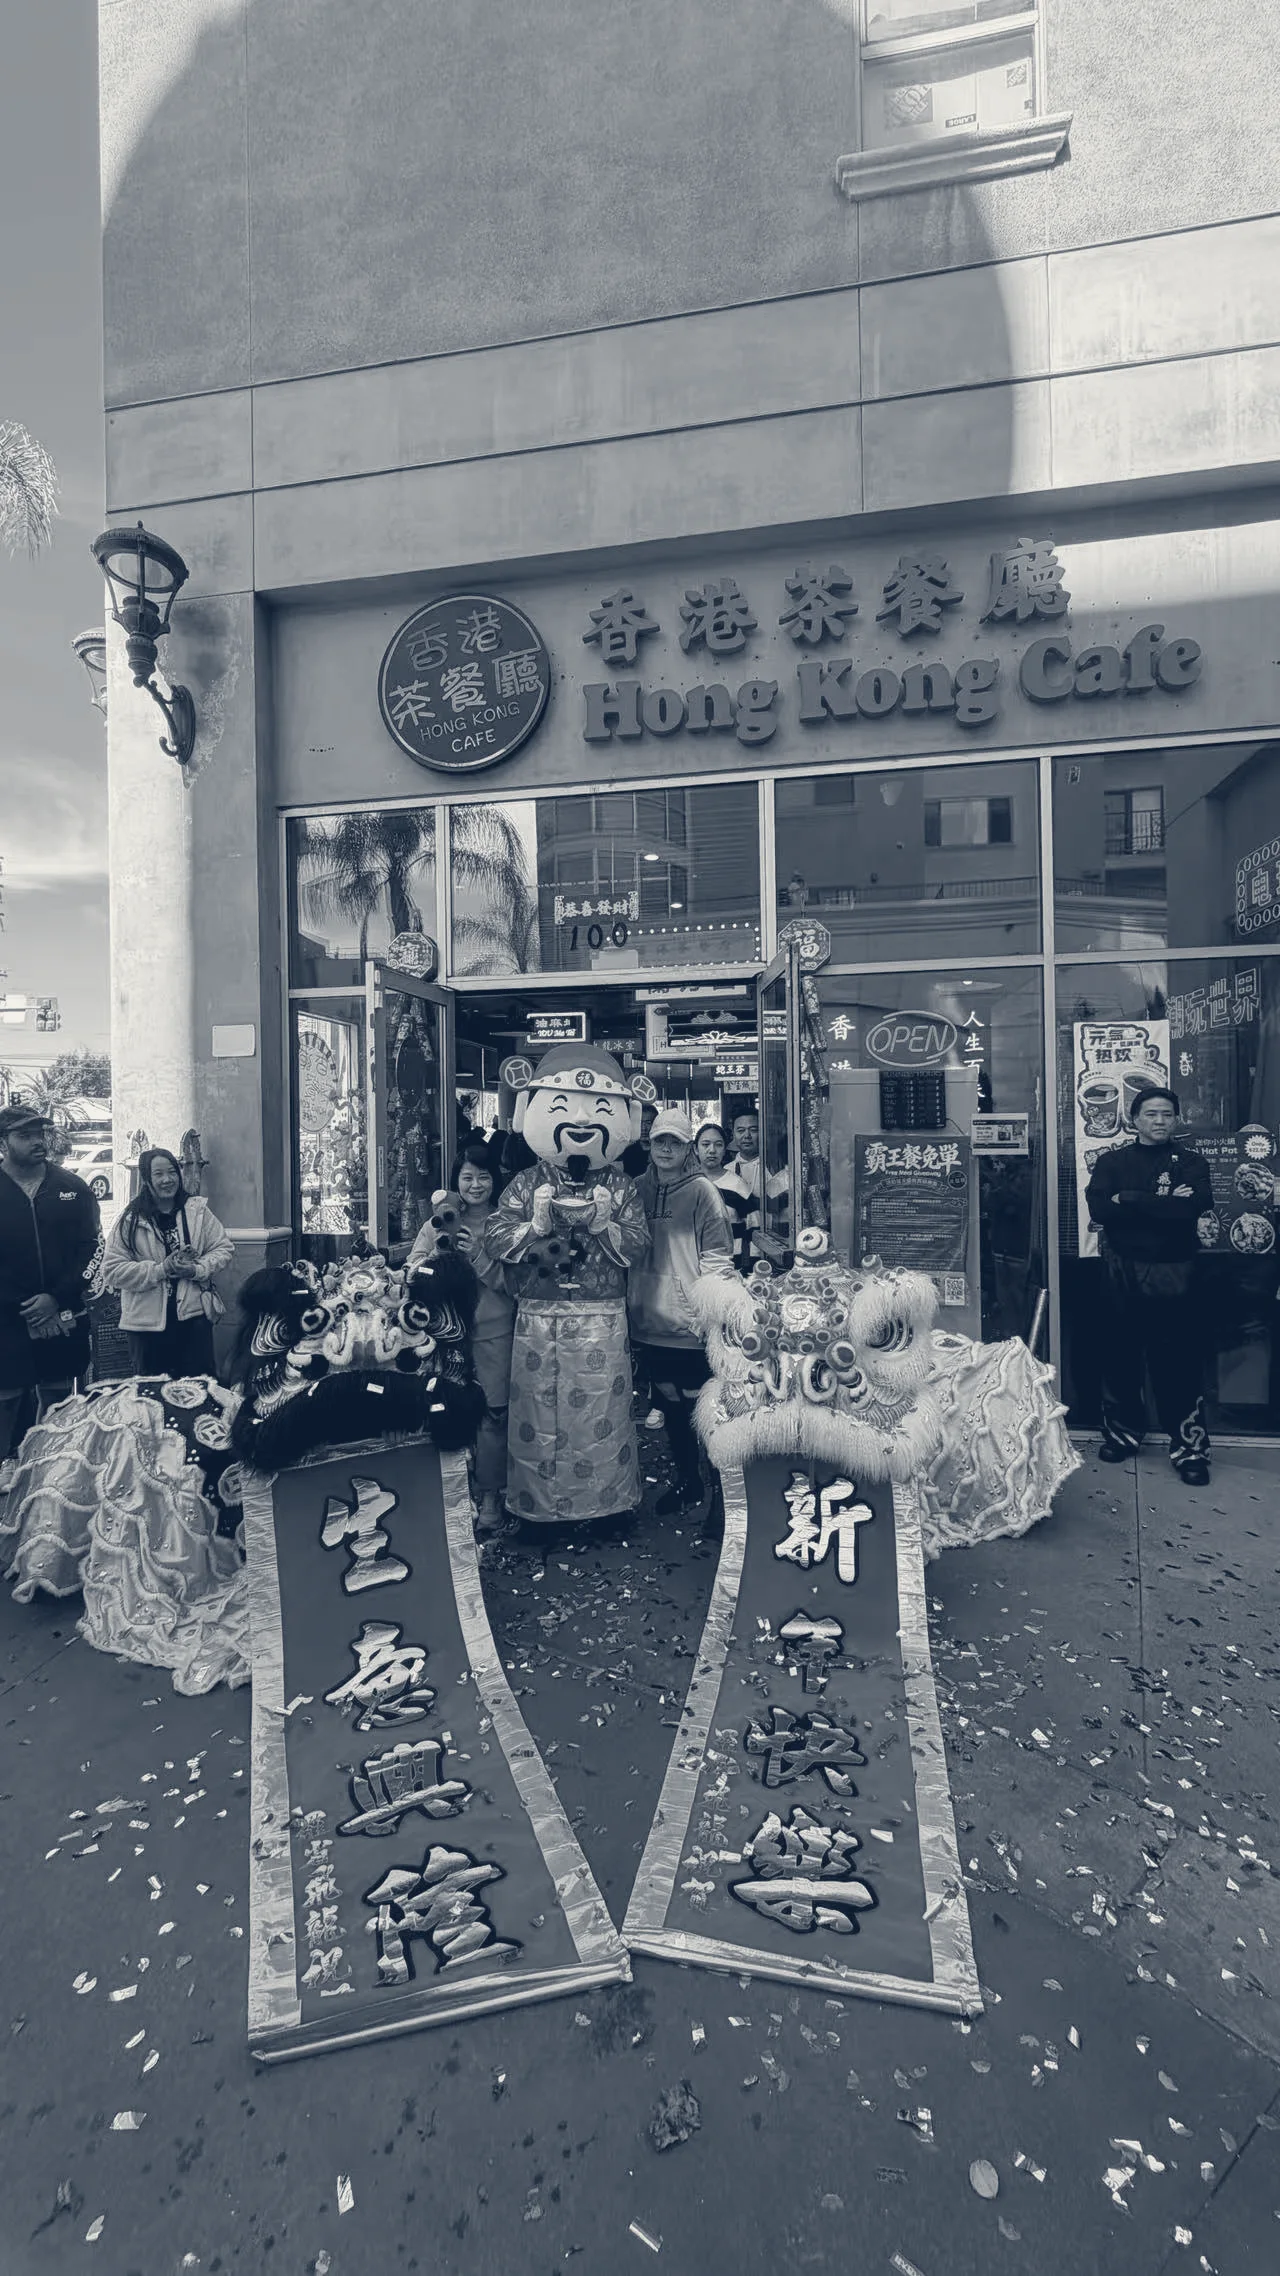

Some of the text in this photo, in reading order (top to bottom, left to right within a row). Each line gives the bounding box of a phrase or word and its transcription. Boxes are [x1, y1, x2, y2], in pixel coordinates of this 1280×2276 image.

[583, 538, 1071, 665] 香港茶餐廳
[405, 606, 502, 672] 香港
[389, 650, 546, 729] 茶餐廳
[582, 624, 1202, 746] Hong Kong Cafe
[420, 701, 521, 741] HONG KONG
[451, 728, 497, 752] CAFE
[563, 898, 630, 918] 恭喜發財
[569, 921, 628, 951] 100
[871, 1024, 949, 1053] OPEN
[577, 1072, 592, 1085] 福
[864, 1141, 962, 1177] 霸王餐免單
[1201, 1147, 1218, 1155] Hot
[1221, 1146, 1238, 1154] Pot
